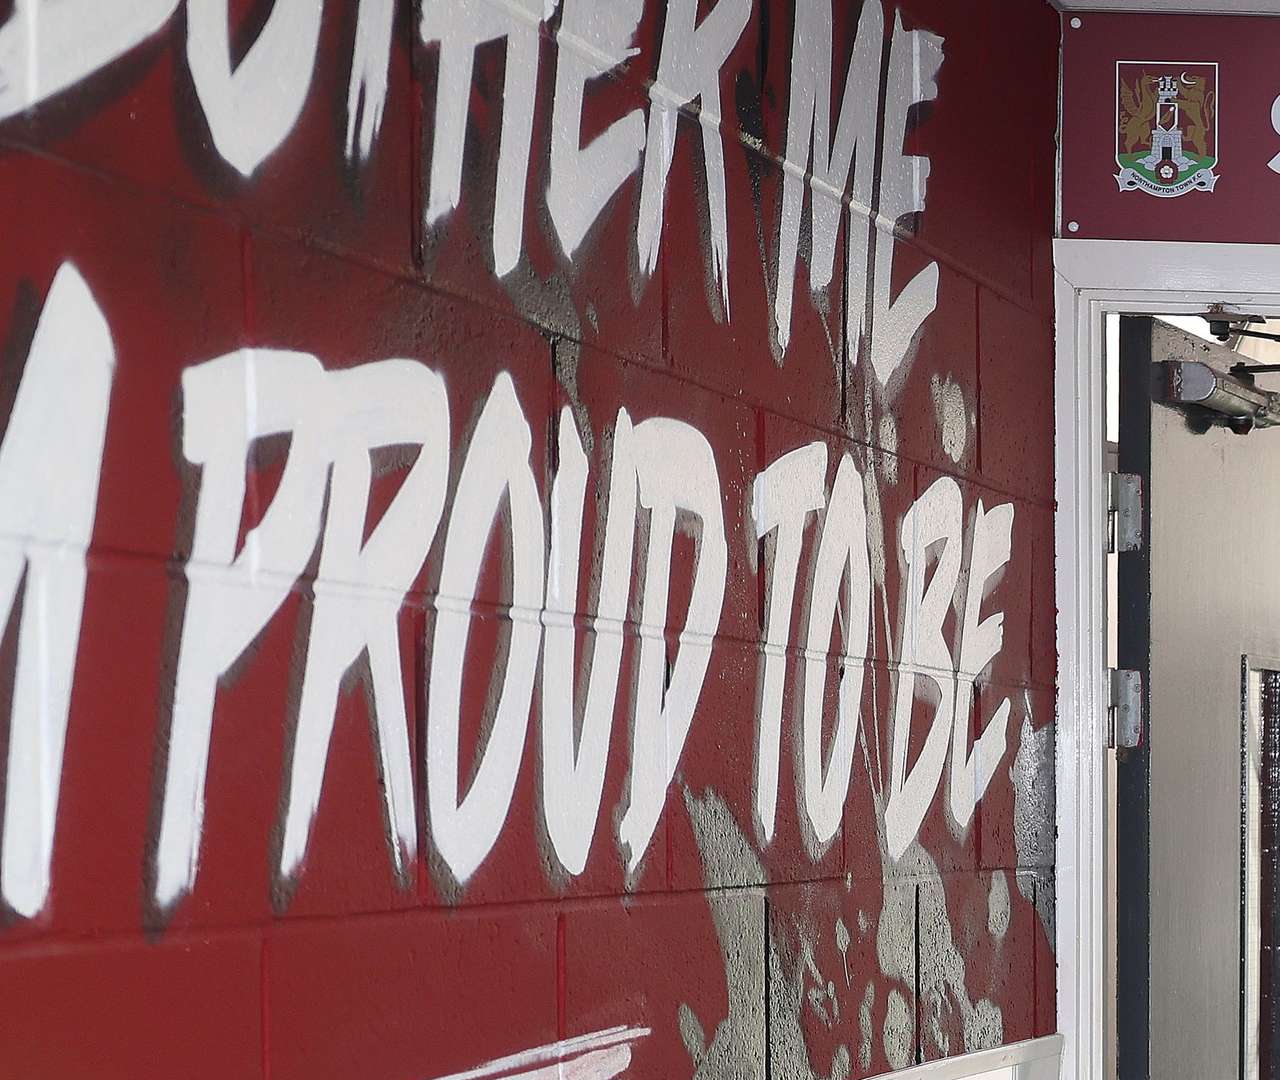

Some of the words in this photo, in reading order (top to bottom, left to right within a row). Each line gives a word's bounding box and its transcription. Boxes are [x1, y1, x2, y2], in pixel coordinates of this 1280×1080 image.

[775, 0, 945, 387] ME
[1131, 172, 1175, 193] NORTHAMPTON
[1176, 179, 1193, 191] TOWN
[156, 347, 728, 906] PROUD
[753, 441, 871, 843] TO
[884, 477, 1015, 859] BE
